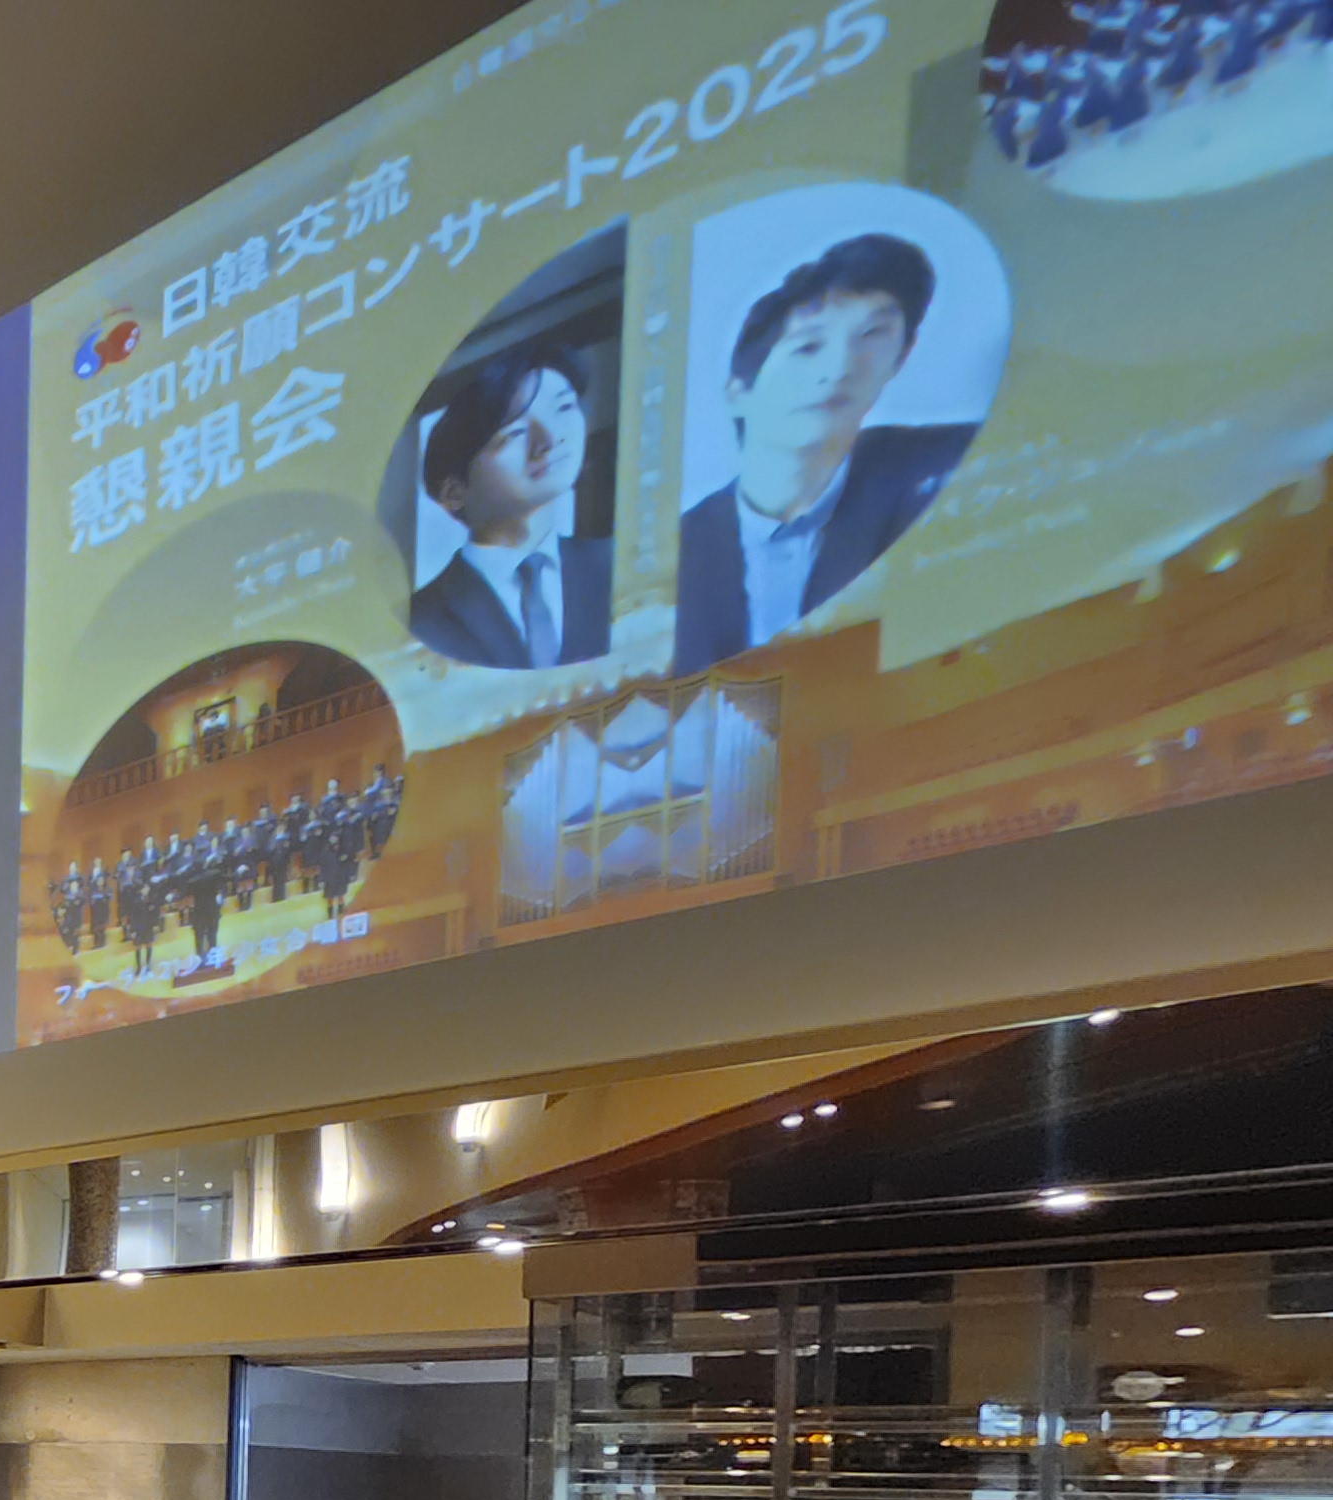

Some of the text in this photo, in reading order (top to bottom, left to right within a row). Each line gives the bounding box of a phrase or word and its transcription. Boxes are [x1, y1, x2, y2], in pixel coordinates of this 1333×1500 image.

[70, 1, 890, 450] 平和祈願コンサート2025
[161, 154, 411, 339] 日韓交流
[68, 366, 347, 553] 懇親会
